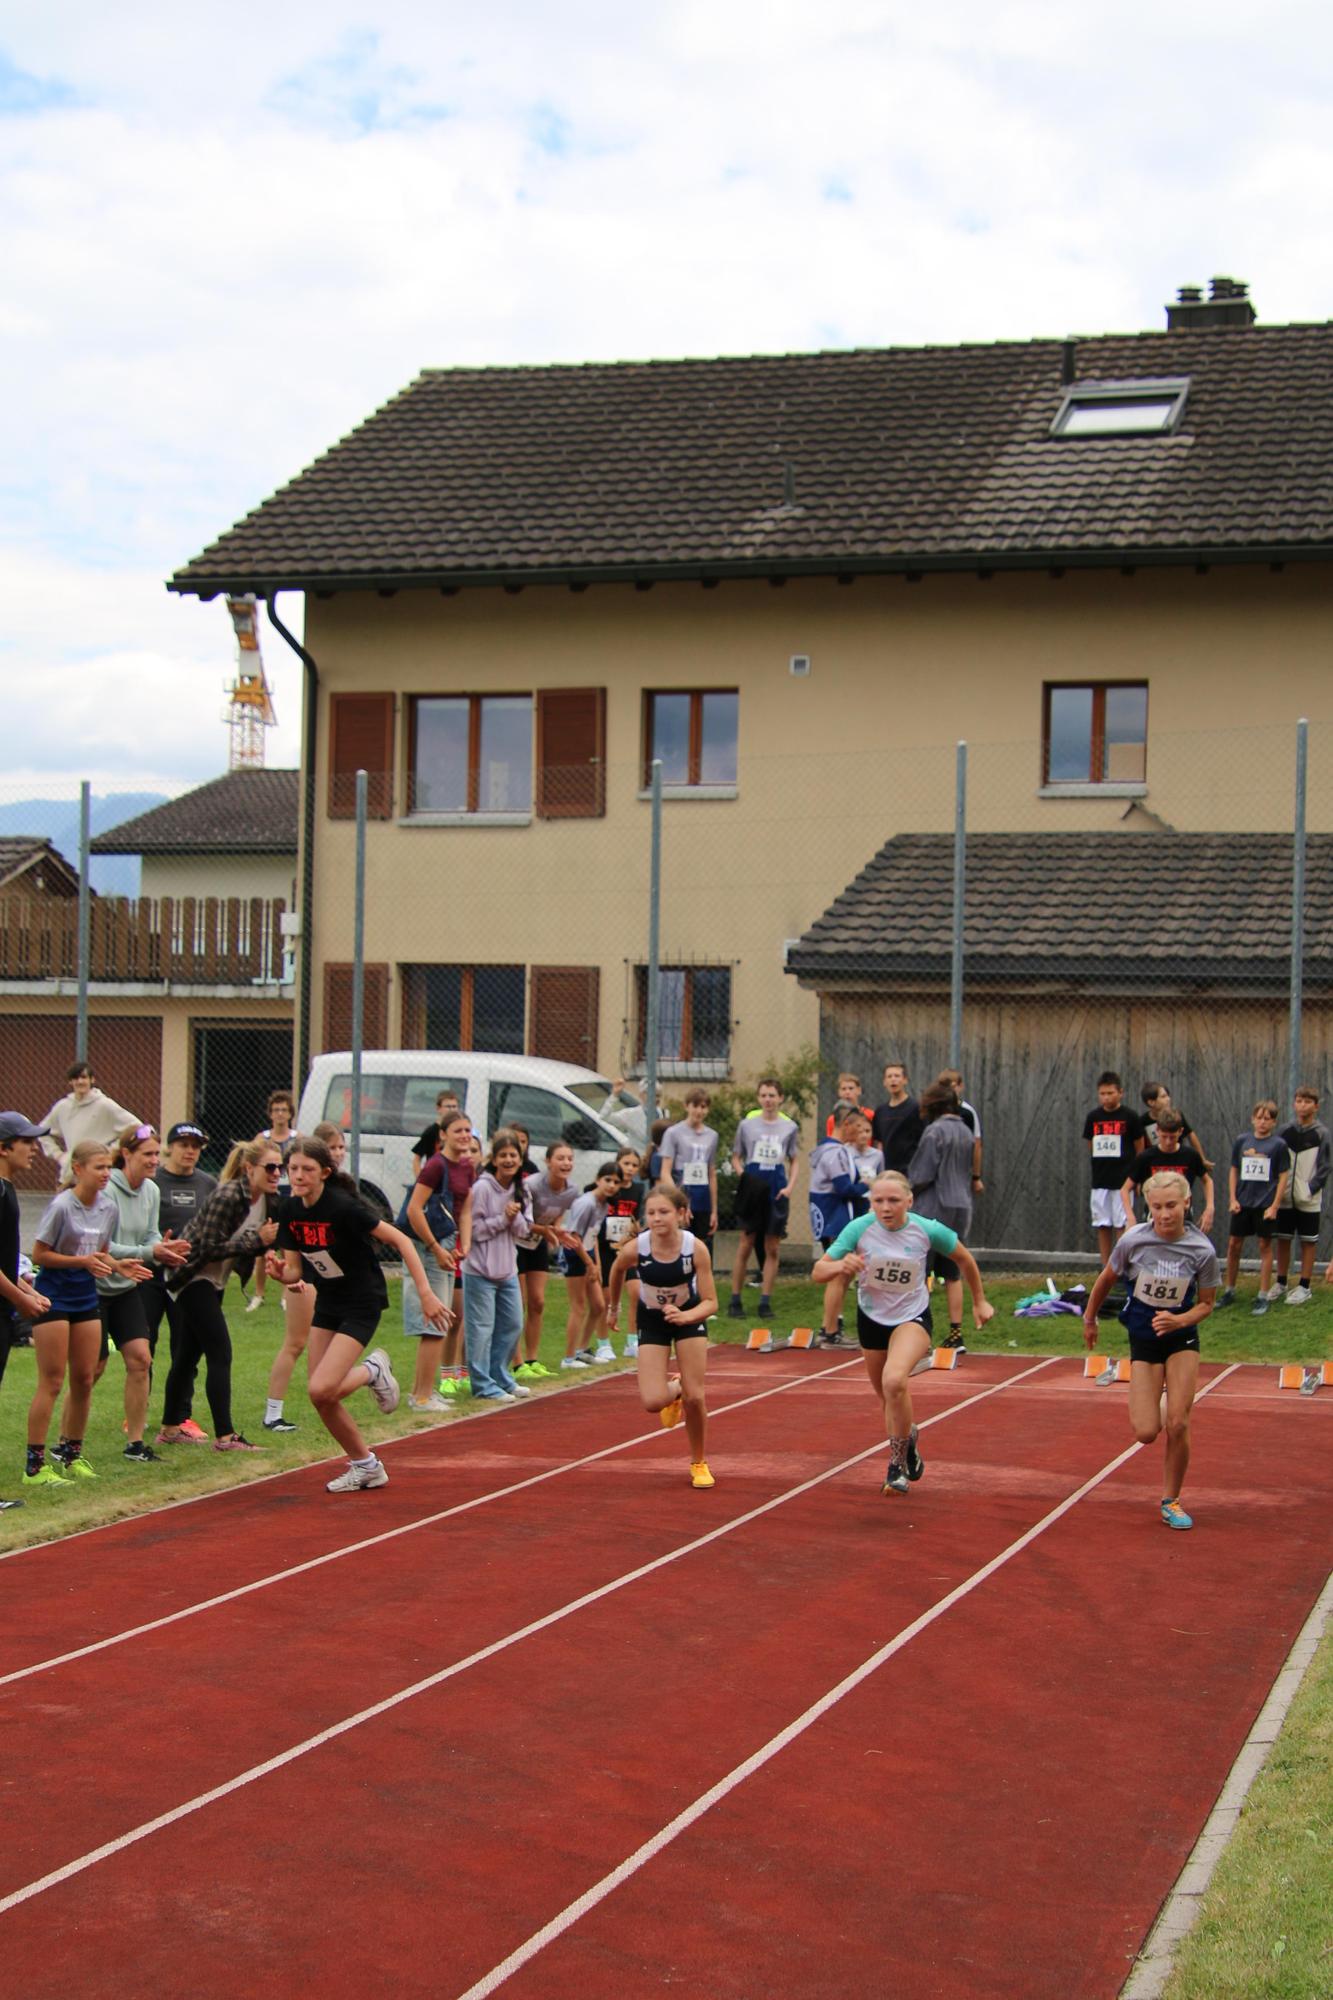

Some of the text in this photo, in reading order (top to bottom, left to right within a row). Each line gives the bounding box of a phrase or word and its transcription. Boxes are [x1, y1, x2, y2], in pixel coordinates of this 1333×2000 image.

[1096, 1141, 1117, 1151] 146
[1245, 1164, 1265, 1174] 171
[874, 1267, 912, 1285] 158
[1142, 1283, 1179, 1300] 181
[656, 1294, 678, 1305] 97
